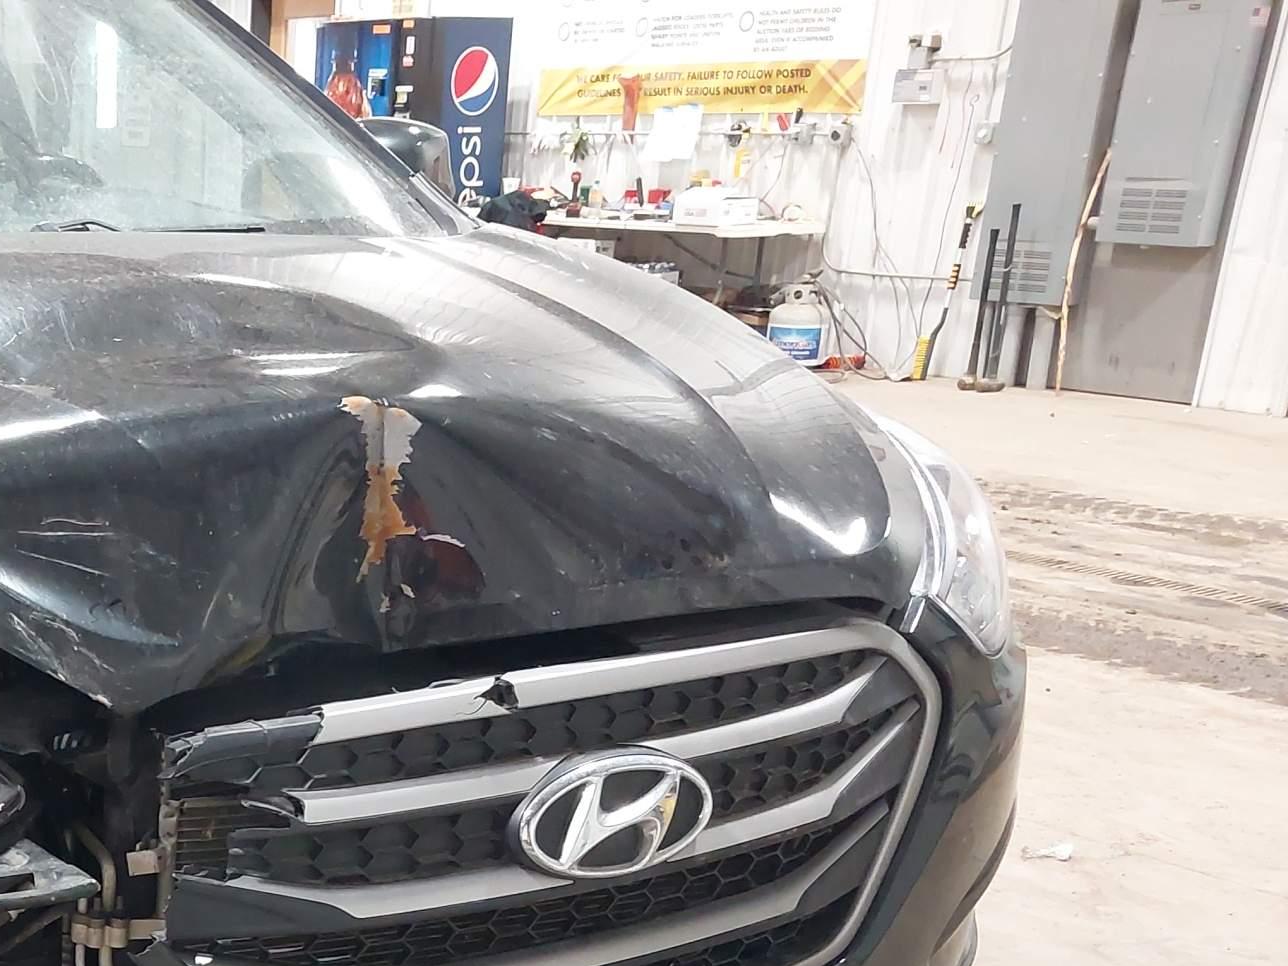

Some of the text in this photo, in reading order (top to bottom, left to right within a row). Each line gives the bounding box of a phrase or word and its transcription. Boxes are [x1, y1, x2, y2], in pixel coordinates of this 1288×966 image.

[687, 71, 720, 81] FAILURE
[722, 70, 734, 79] TO
[736, 69, 773, 79] FOLLOW
[775, 68, 812, 78] POSTED
[643, 87, 671, 96] RESULT
[673, 87, 683, 95] IN
[685, 86, 720, 96] SERIOUS
[723, 85, 756, 95] INJURY
[759, 85, 773, 94] OR
[775, 84, 809, 94] DEATH.
